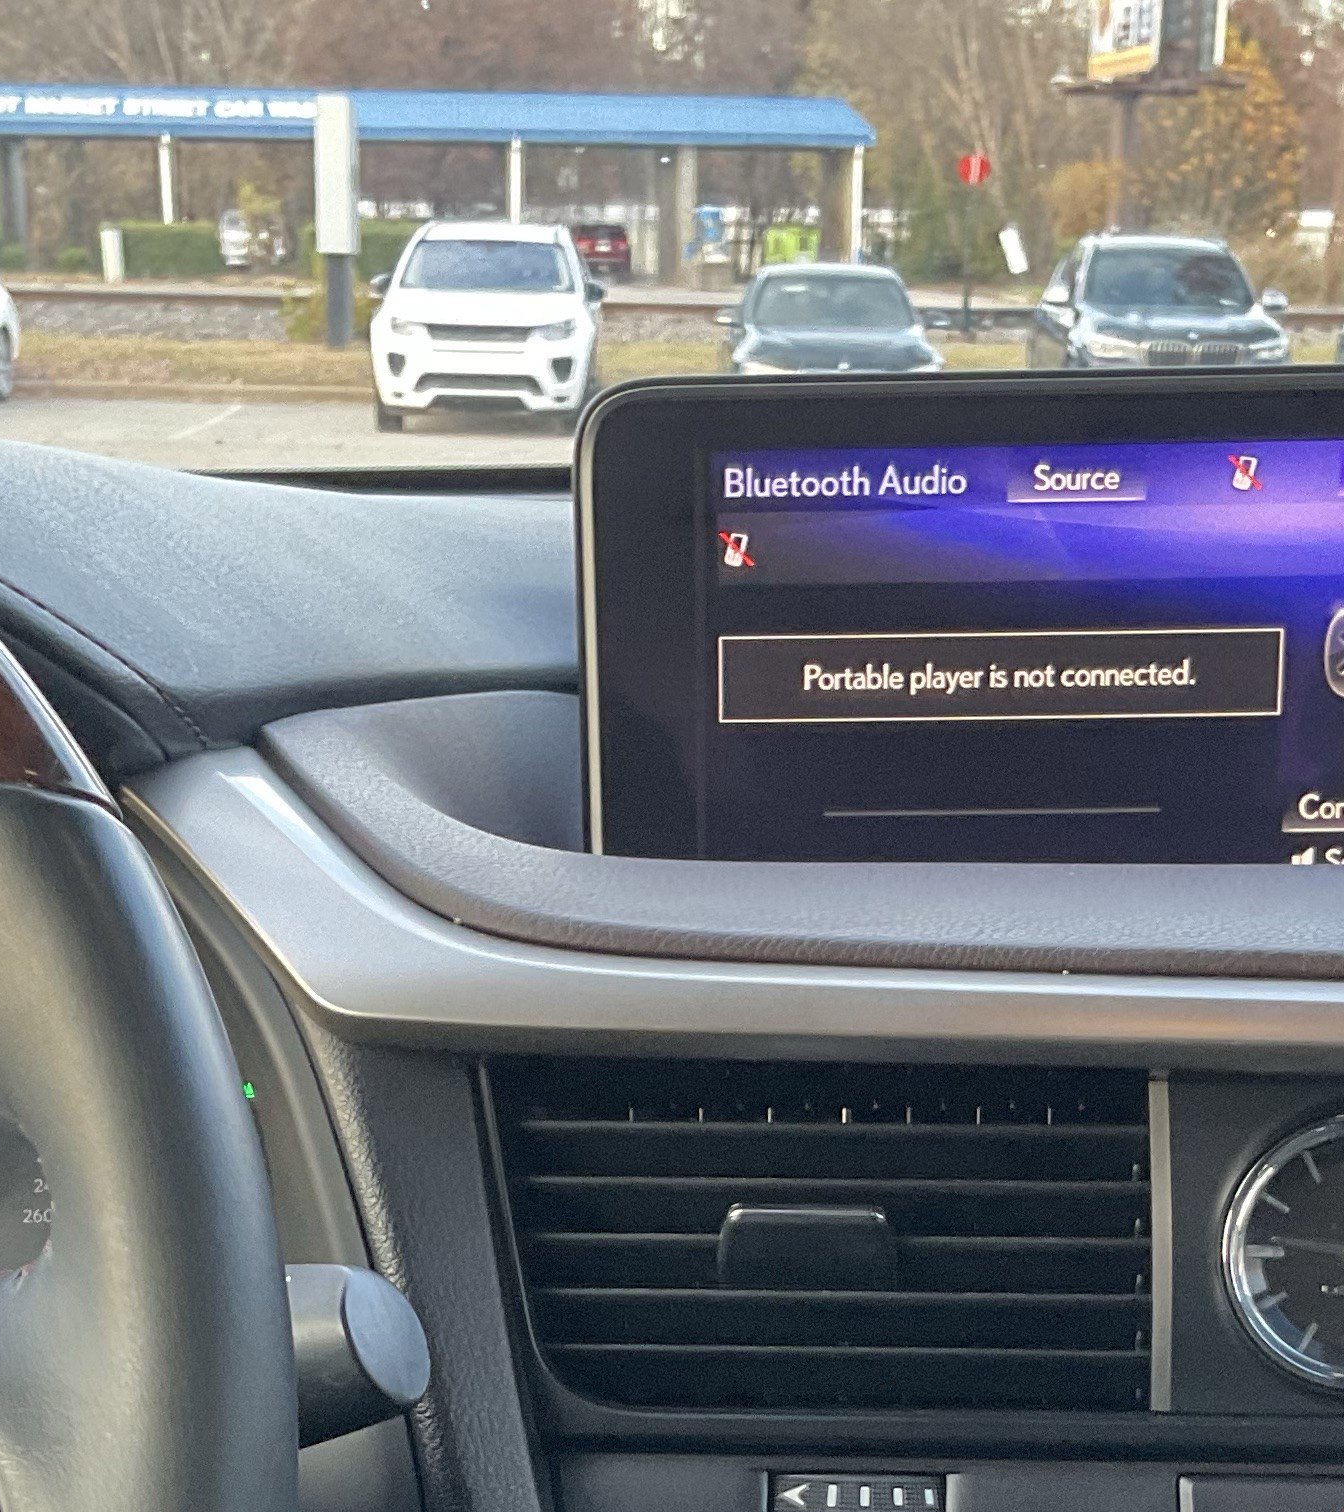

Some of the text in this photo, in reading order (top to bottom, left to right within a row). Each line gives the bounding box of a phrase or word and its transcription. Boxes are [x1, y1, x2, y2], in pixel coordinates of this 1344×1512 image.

[724, 464, 968, 498] Bluetooth Audio
[1033, 464, 1121, 491] Source
[803, 658, 1196, 696] Portable player is not connected.
